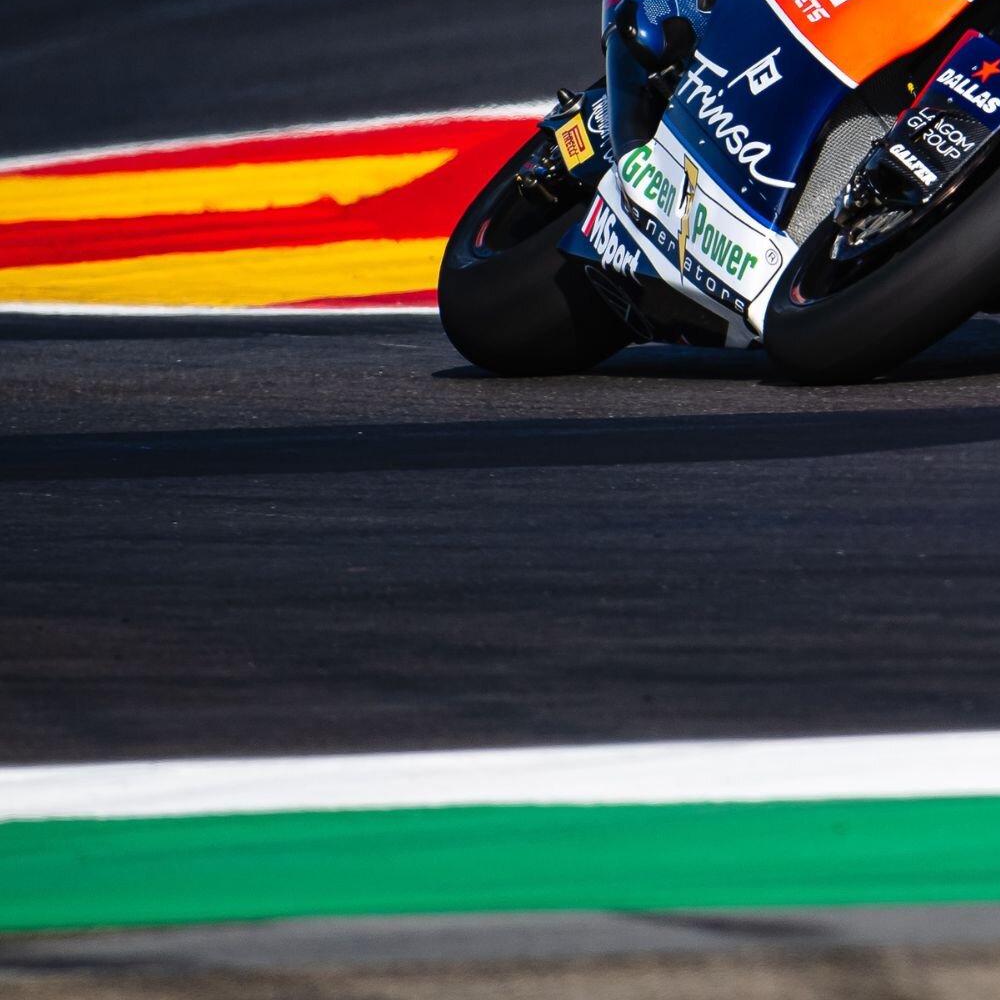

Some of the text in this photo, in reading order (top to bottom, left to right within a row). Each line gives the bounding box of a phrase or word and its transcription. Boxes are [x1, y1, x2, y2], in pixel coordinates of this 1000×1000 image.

[889, 143, 938, 186] GALFER
[622, 145, 677, 217] Green
[691, 203, 758, 281] Power
